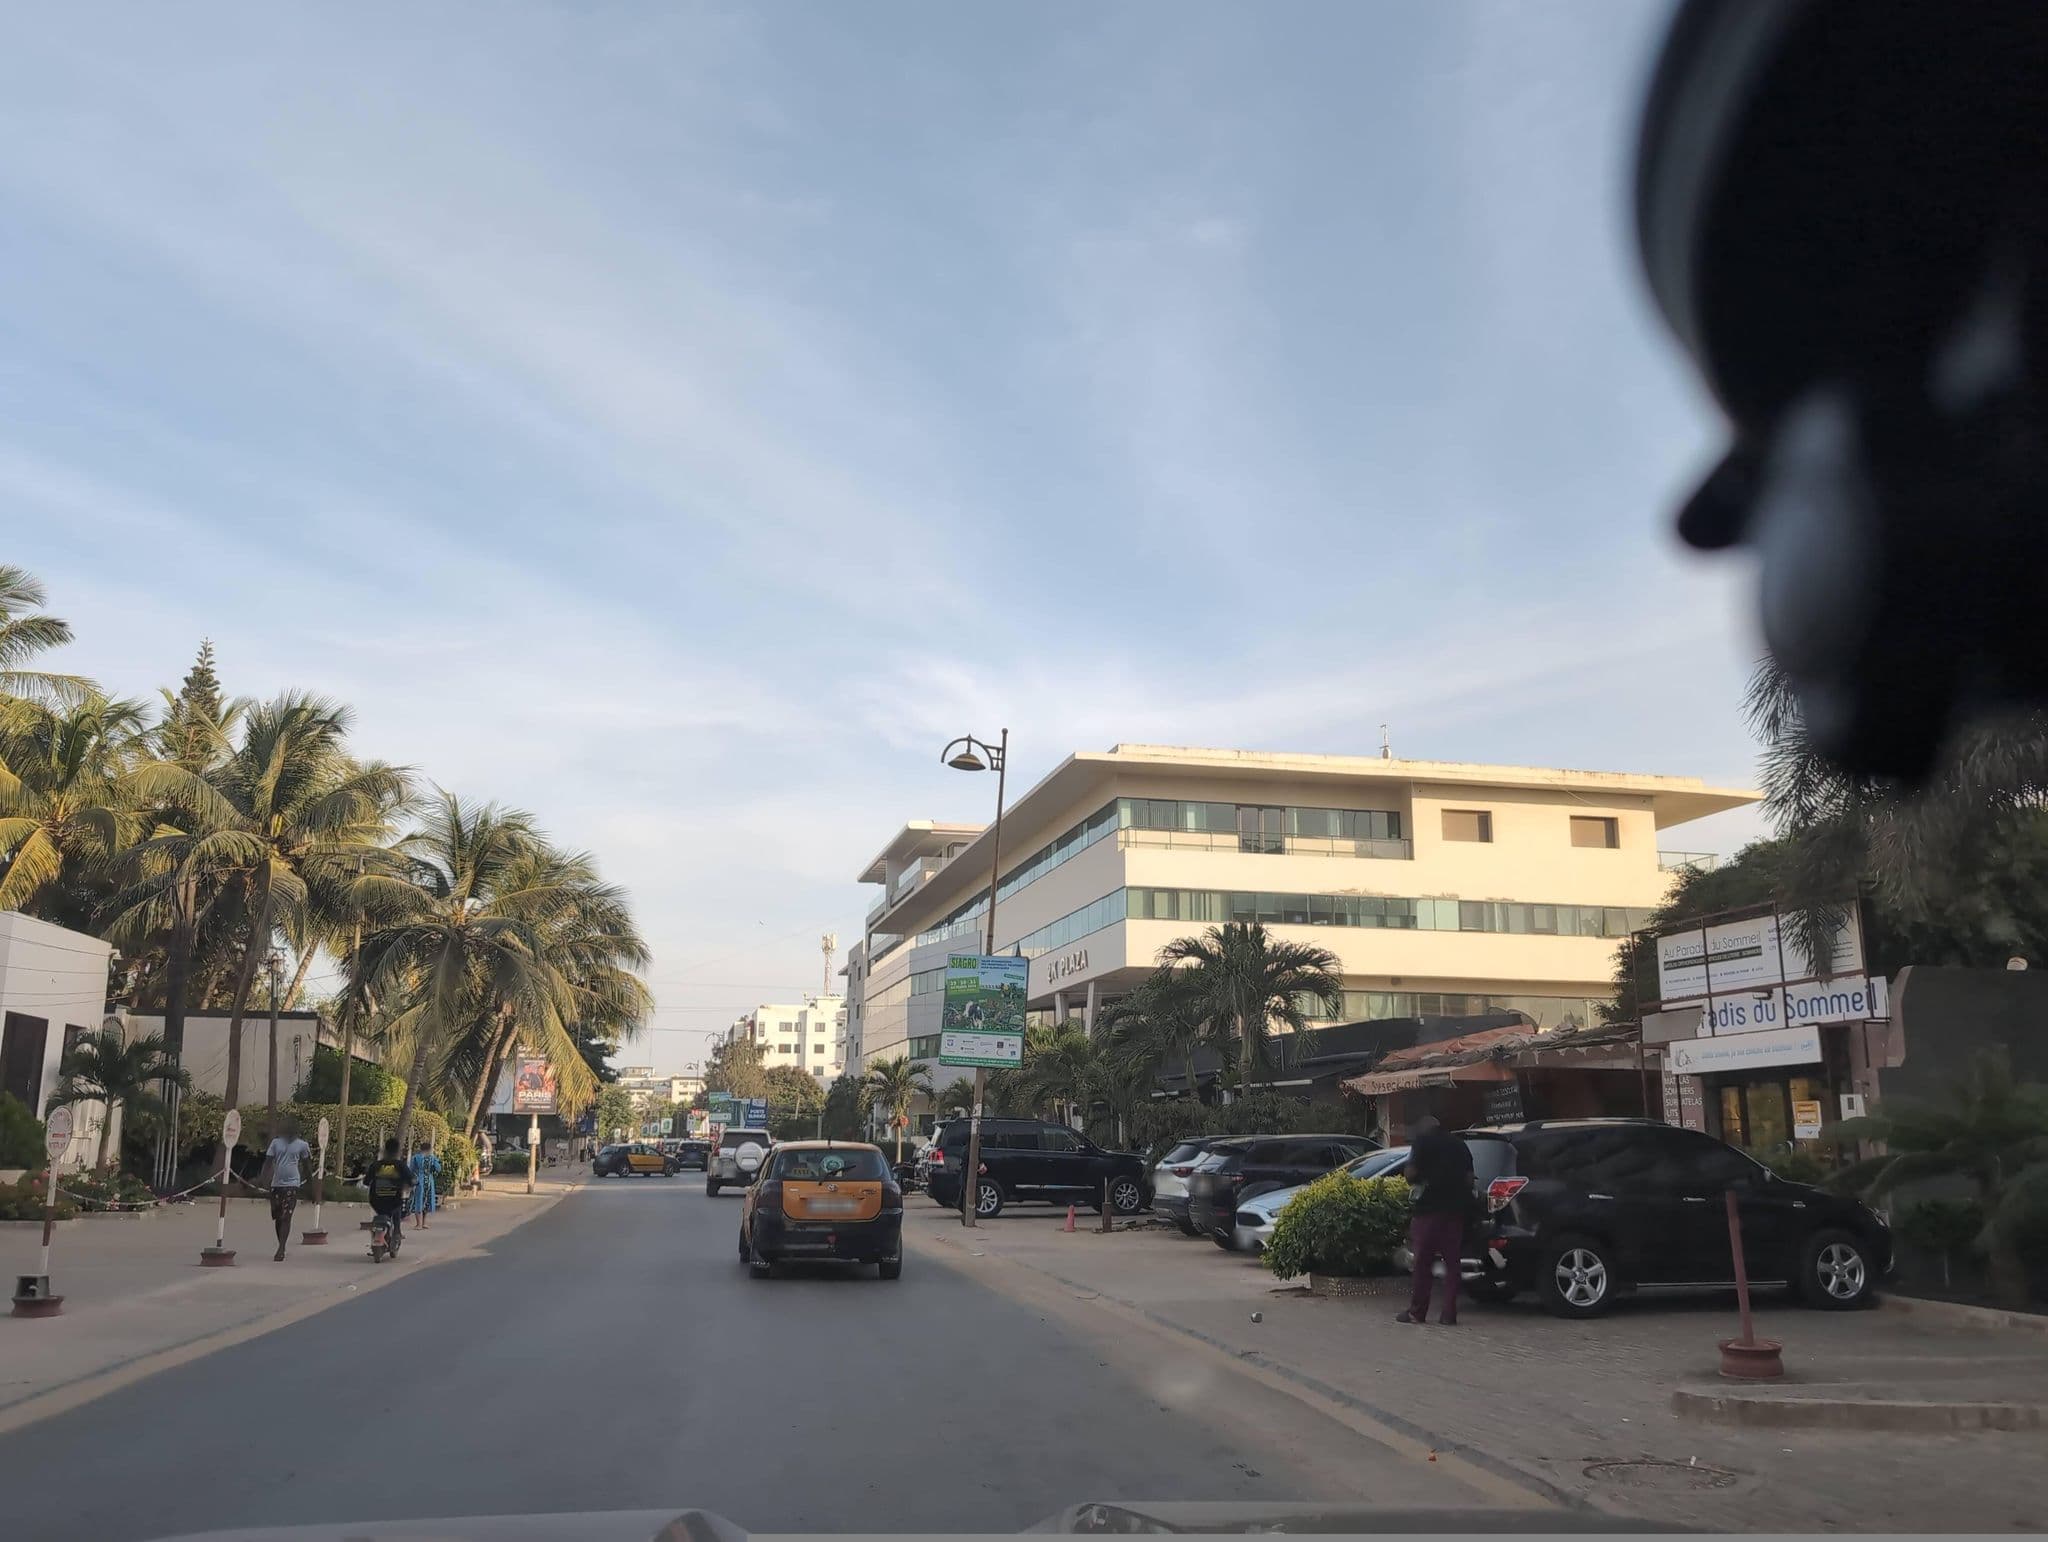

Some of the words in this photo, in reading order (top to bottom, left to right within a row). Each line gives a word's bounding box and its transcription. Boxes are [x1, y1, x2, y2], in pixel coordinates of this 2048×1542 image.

[1676, 941, 1704, 957] Paradi
[1722, 931, 1761, 949] Sommeil
[950, 957, 977, 969] SIAGRO
[1061, 949, 1089, 977] PLAZA
[1753, 999, 1776, 1024] du
[1785, 983, 1878, 1020] Sommeil
[1664, 1076, 1690, 1085] MATLAS
[1665, 1087, 1695, 1096] SOMIERS
[1665, 1097, 1703, 1106] SURATELAS
